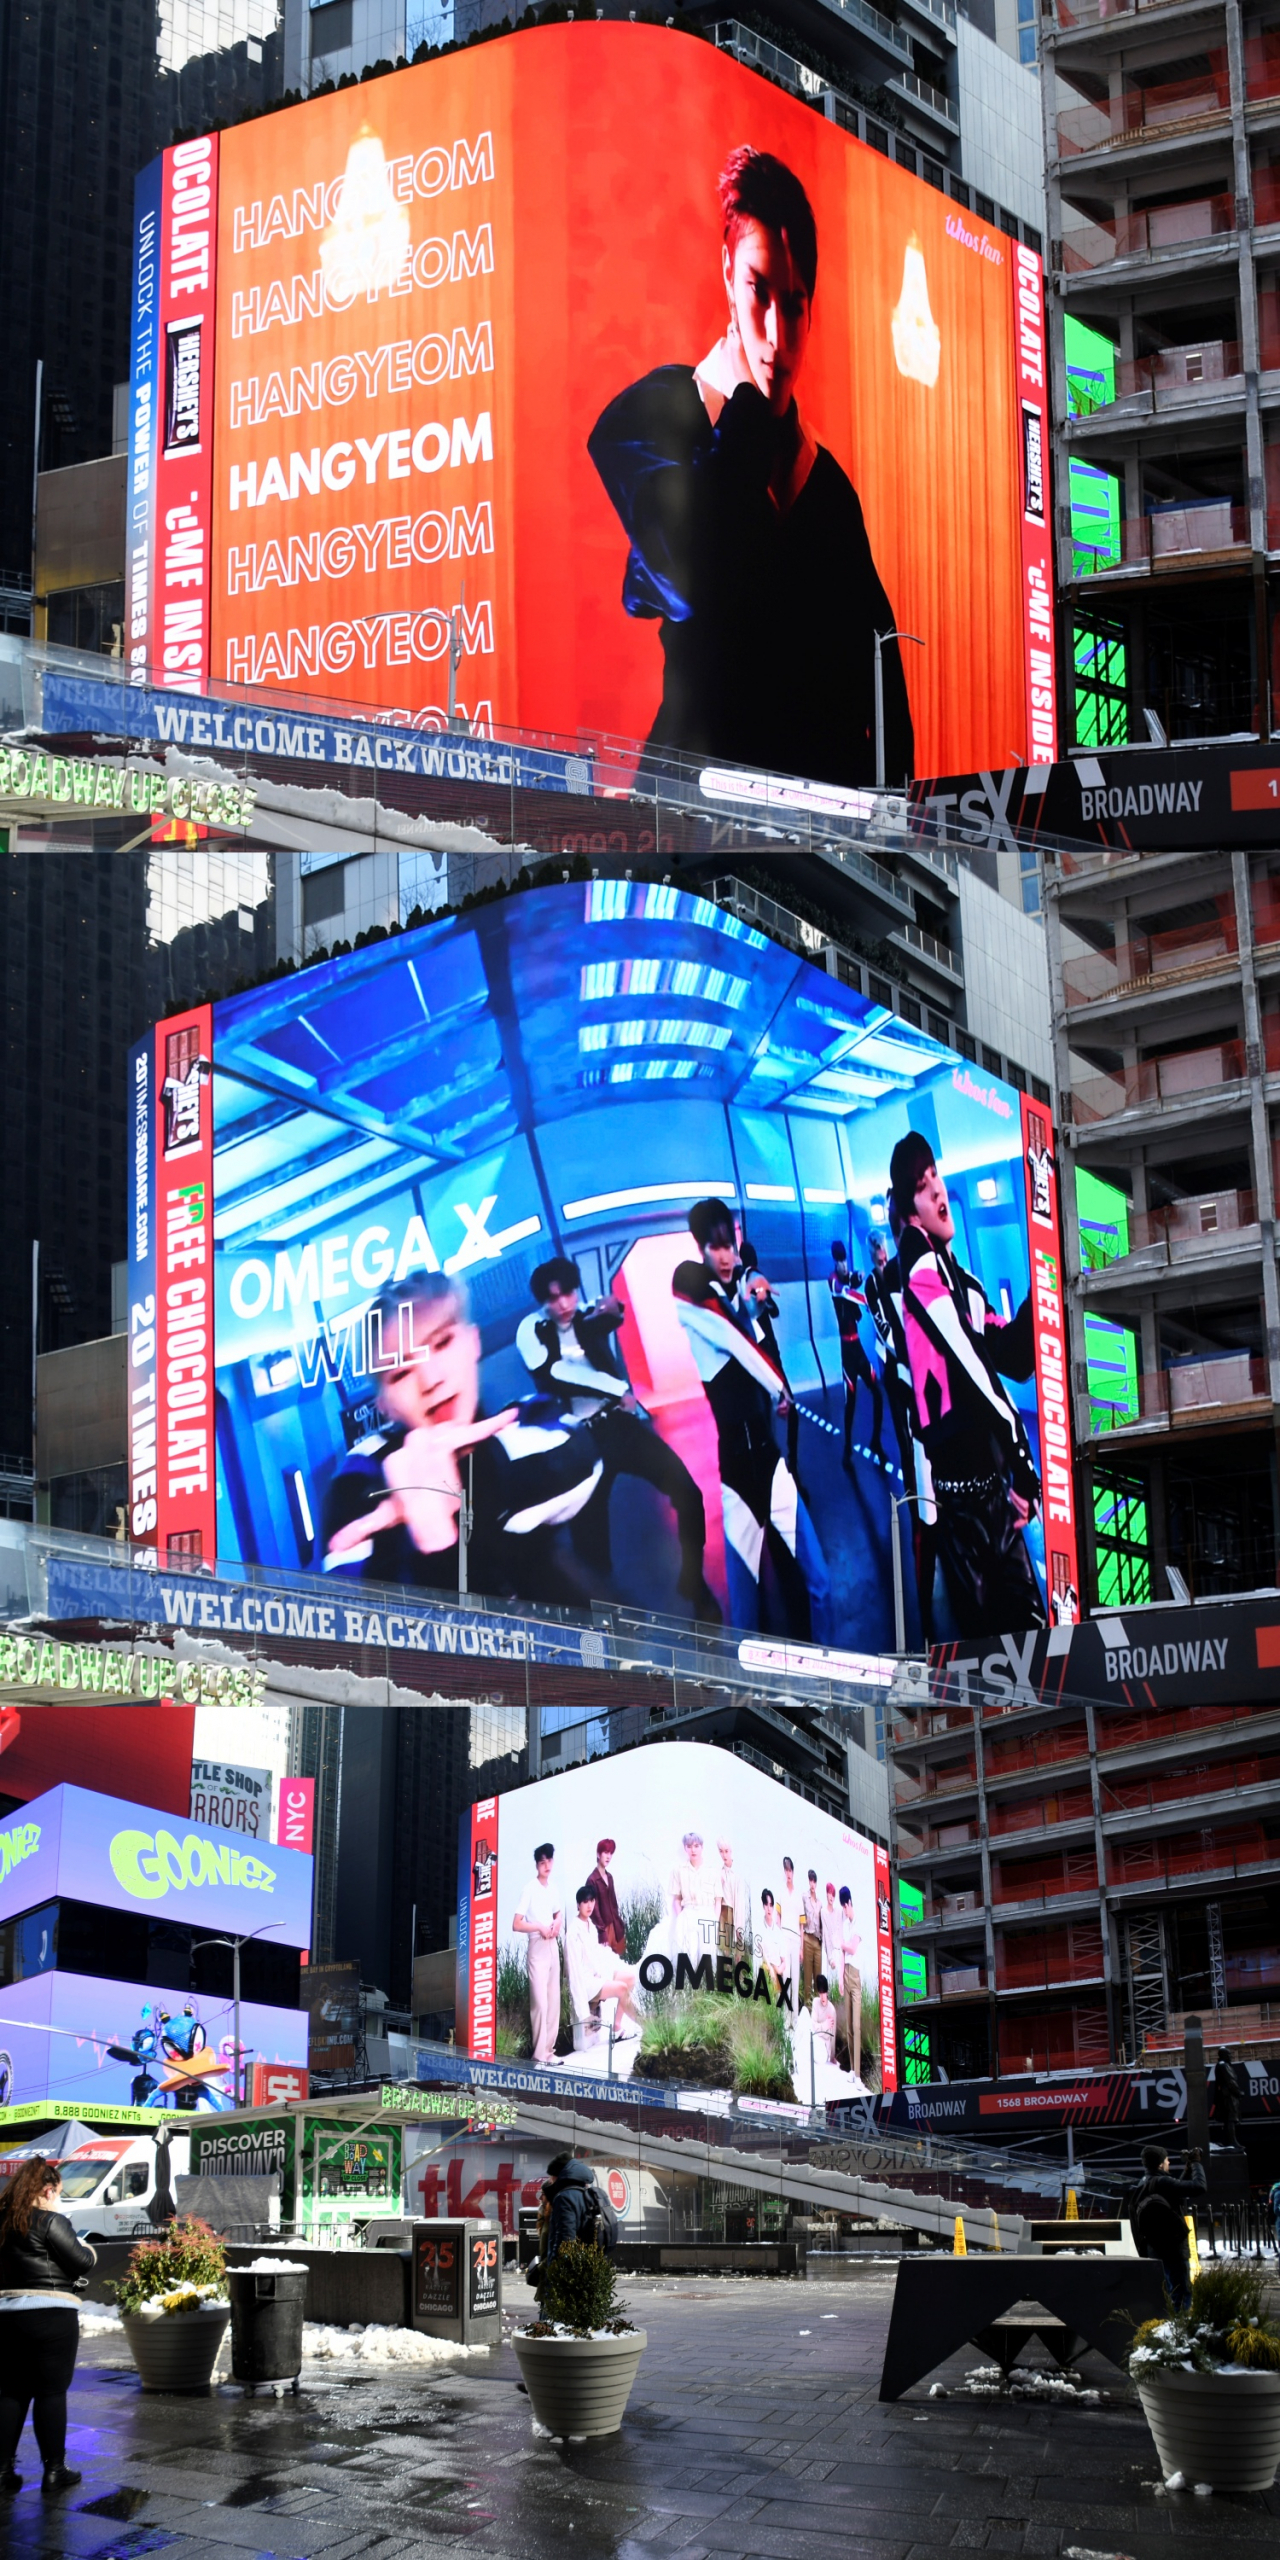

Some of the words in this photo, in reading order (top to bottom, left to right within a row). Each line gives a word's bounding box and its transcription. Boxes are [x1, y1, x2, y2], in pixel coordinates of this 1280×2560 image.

[137, 210, 156, 323] UNLOCK
[135, 322, 152, 380] THE
[230, 320, 495, 429] HANGYEOM
[132, 380, 152, 495] POWER
[228, 411, 494, 511] HANGYEOM
[132, 500, 149, 533] OF
[227, 501, 495, 596] HANGYEOM
[130, 539, 149, 640] TIMES
[226, 600, 495, 687] HANGYEOM
[153, 704, 326, 761] WELCOME
[333, 730, 418, 775] BACK
[420, 745, 522, 787] WORLD!
[130, 766, 168, 814] UP
[925, 767, 1020, 852] TSX
[1081, 780, 1204, 822] BROADWAY
[166, 1181, 206, 1273] FREE
[229, 1214, 441, 1320] OMEGA
[450, 1194, 503, 1266] X
[1034, 1248, 1061, 1329] FREE
[131, 1294, 156, 1369] 20
[291, 1301, 430, 1388] WILL
[166, 1276, 209, 1498] CHOCOLATE
[131, 1372, 158, 1536] TIMES
[1039, 1331, 1071, 1525] CHOCOLATE
[160, 1588, 336, 1641] WELCOME
[344, 1610, 428, 1652] BACK
[433, 1623, 535, 1661] WORLD!
[137, 1654, 177, 1699] UP
[946, 1629, 1040, 1706] TSX
[1104, 1637, 1229, 1683] BROADWAY
[224, 1767, 263, 1798] SHOP
[190, 1792, 262, 1838] RRORS
[285, 1790, 306, 1842] NYC
[474, 1910, 494, 1954] FREE
[698, 1918, 745, 1951] THIS
[749, 1931, 764, 1959] IS
[638, 1952, 772, 2006] OMEGA
[776, 1974, 794, 2012] X
[880, 1945, 893, 1981] FREE
[473, 1955, 494, 2060] CHOCOLATE
[881, 1983, 896, 2075] CHOCOLATE
[380, 2084, 456, 2117] BROADWAY
[457, 2098, 477, 2119] UP
[469, 2066, 551, 2093] WELCOME
[554, 2078, 593, 2099] BACK
[595, 2083, 645, 2105] WORLD!
[908, 2099, 966, 2120] BROADWAY
[996, 2096, 1022, 2108] 1568
[1023, 2091, 1089, 2107] BROADWAY
[82, 2107, 119, 2120] GOONIEZ
[121, 2110, 141, 2121] NFTs
[834, 2093, 880, 2139] TSX
[200, 2129, 286, 2157] DISCOVER
[419, 2240, 455, 2269] 25
[472, 2239, 497, 2268] 25
[419, 2302, 454, 2313] CHICAGO
[422, 2293, 451, 2301] DAZZLE
[473, 2300, 497, 2312] CHICAGO
[475, 2291, 495, 2300] DAZZLE
